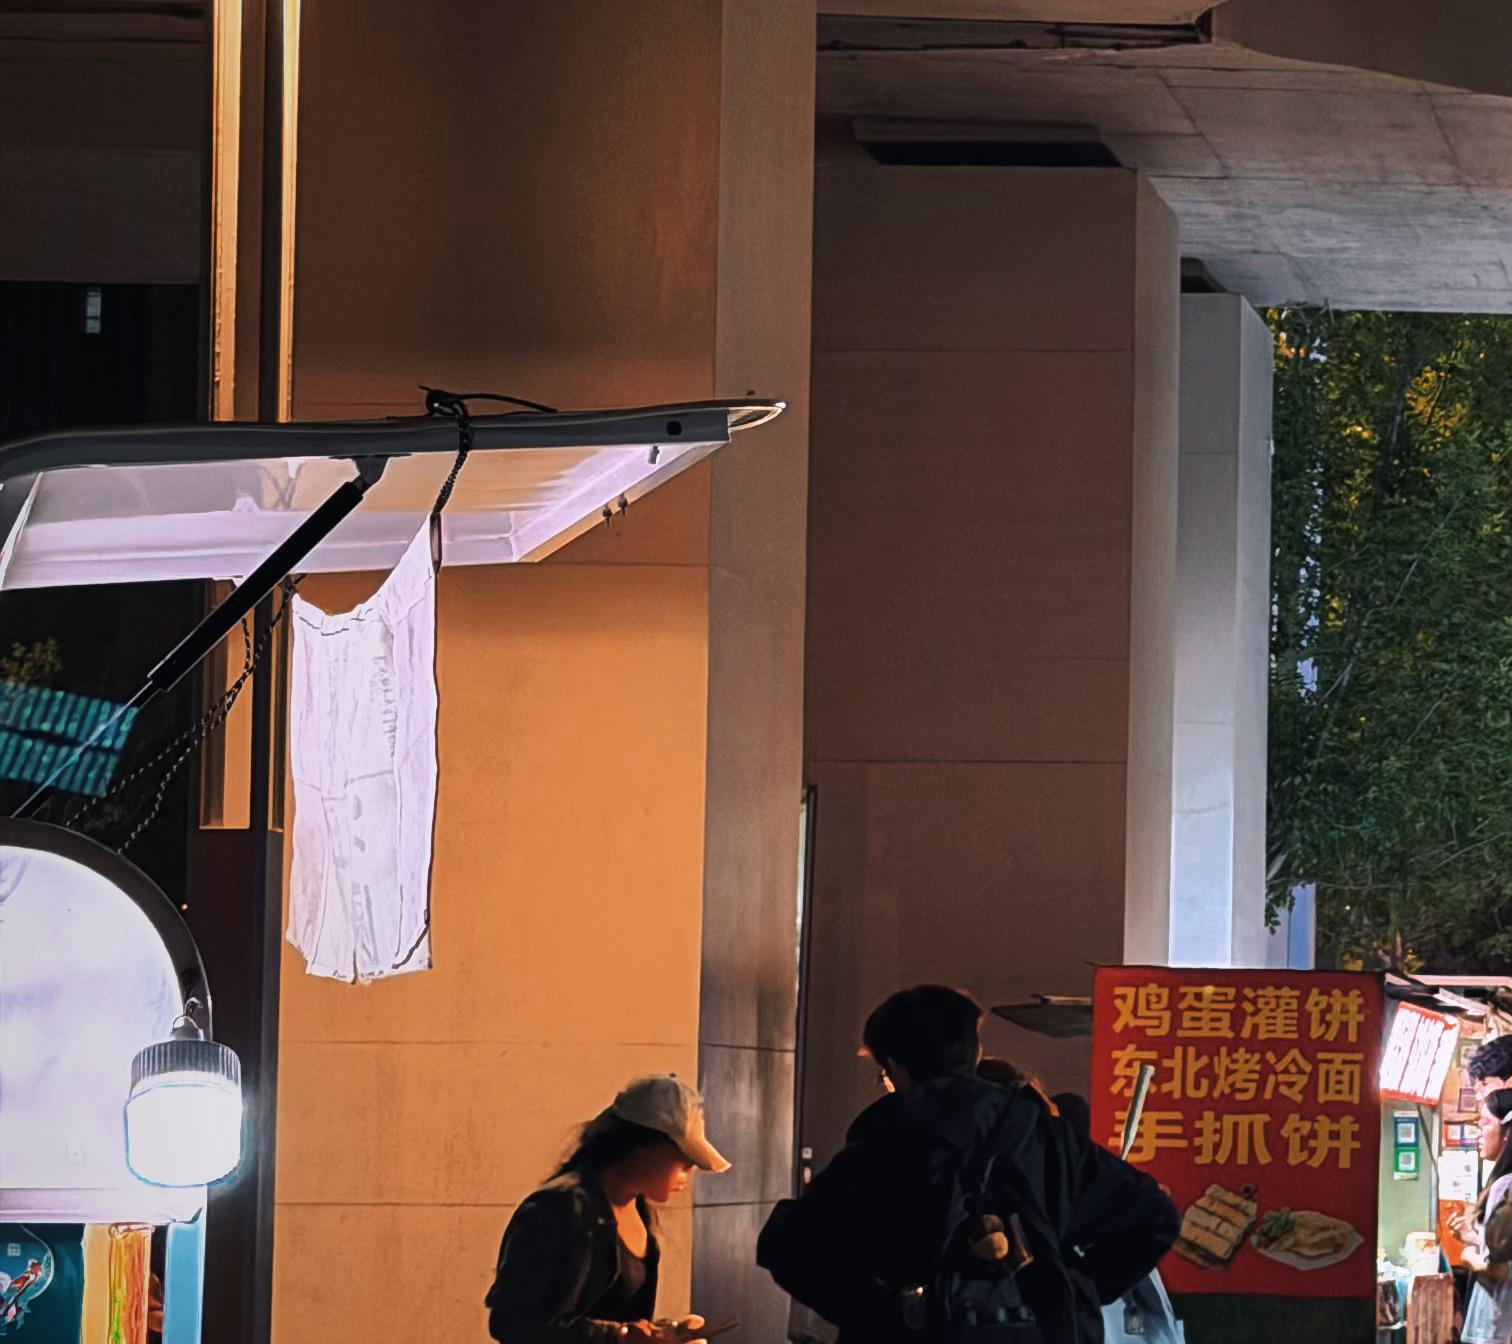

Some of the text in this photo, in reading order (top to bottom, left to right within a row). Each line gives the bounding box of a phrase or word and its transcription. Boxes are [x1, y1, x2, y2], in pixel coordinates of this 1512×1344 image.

[1112, 983, 1365, 1043] 鸡蛋灌饼
[1109, 1044, 1365, 1104] 东北烤冷面
[1108, 1110, 1361, 1169] 手抓饼
